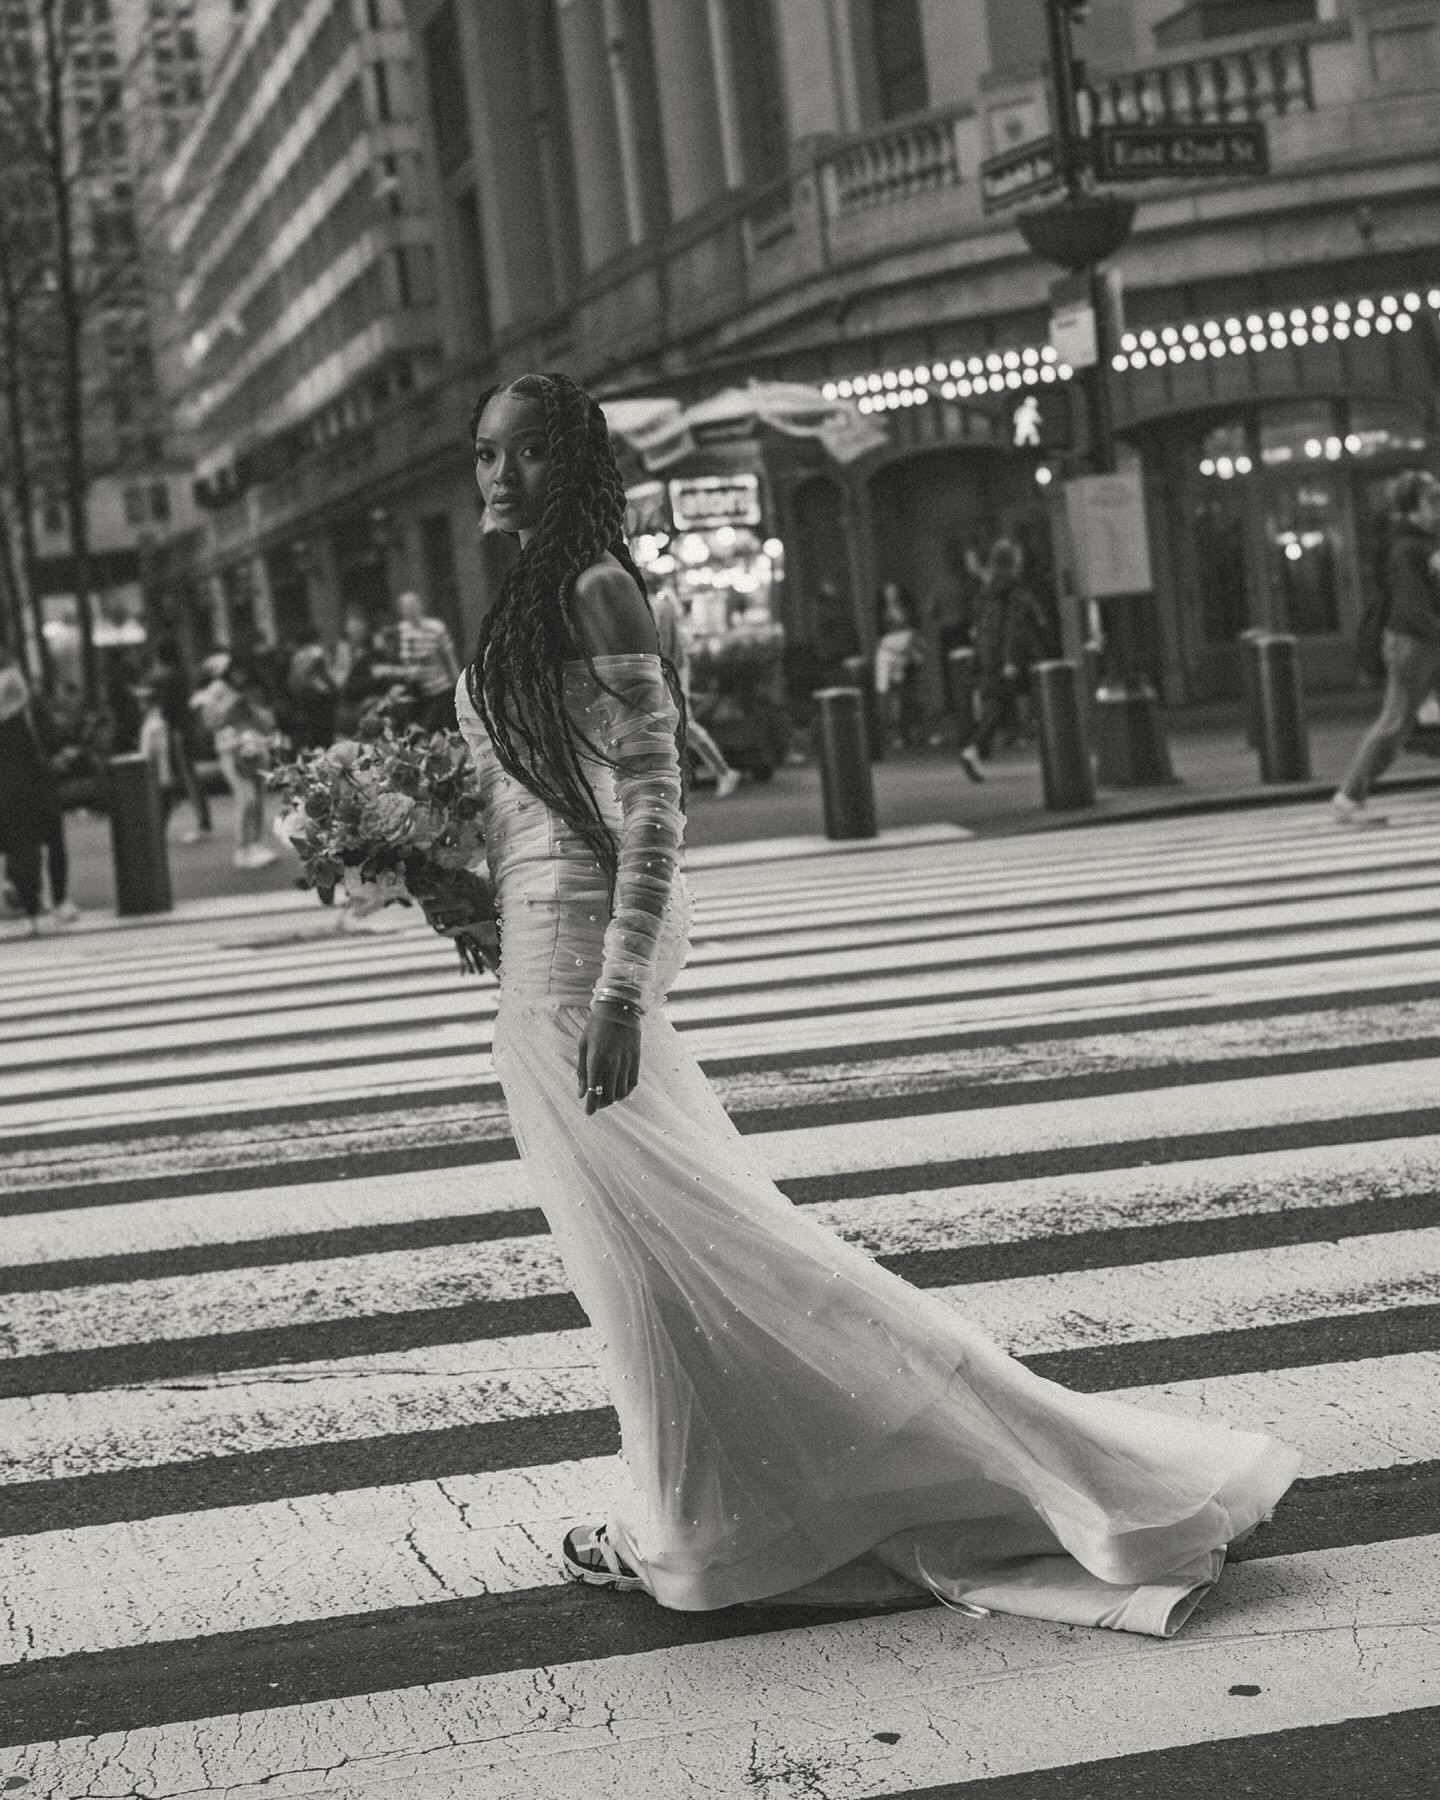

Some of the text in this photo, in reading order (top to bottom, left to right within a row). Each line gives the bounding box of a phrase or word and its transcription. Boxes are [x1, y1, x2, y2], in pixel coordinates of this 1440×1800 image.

[1114, 137, 1255, 164] East 42nd St
